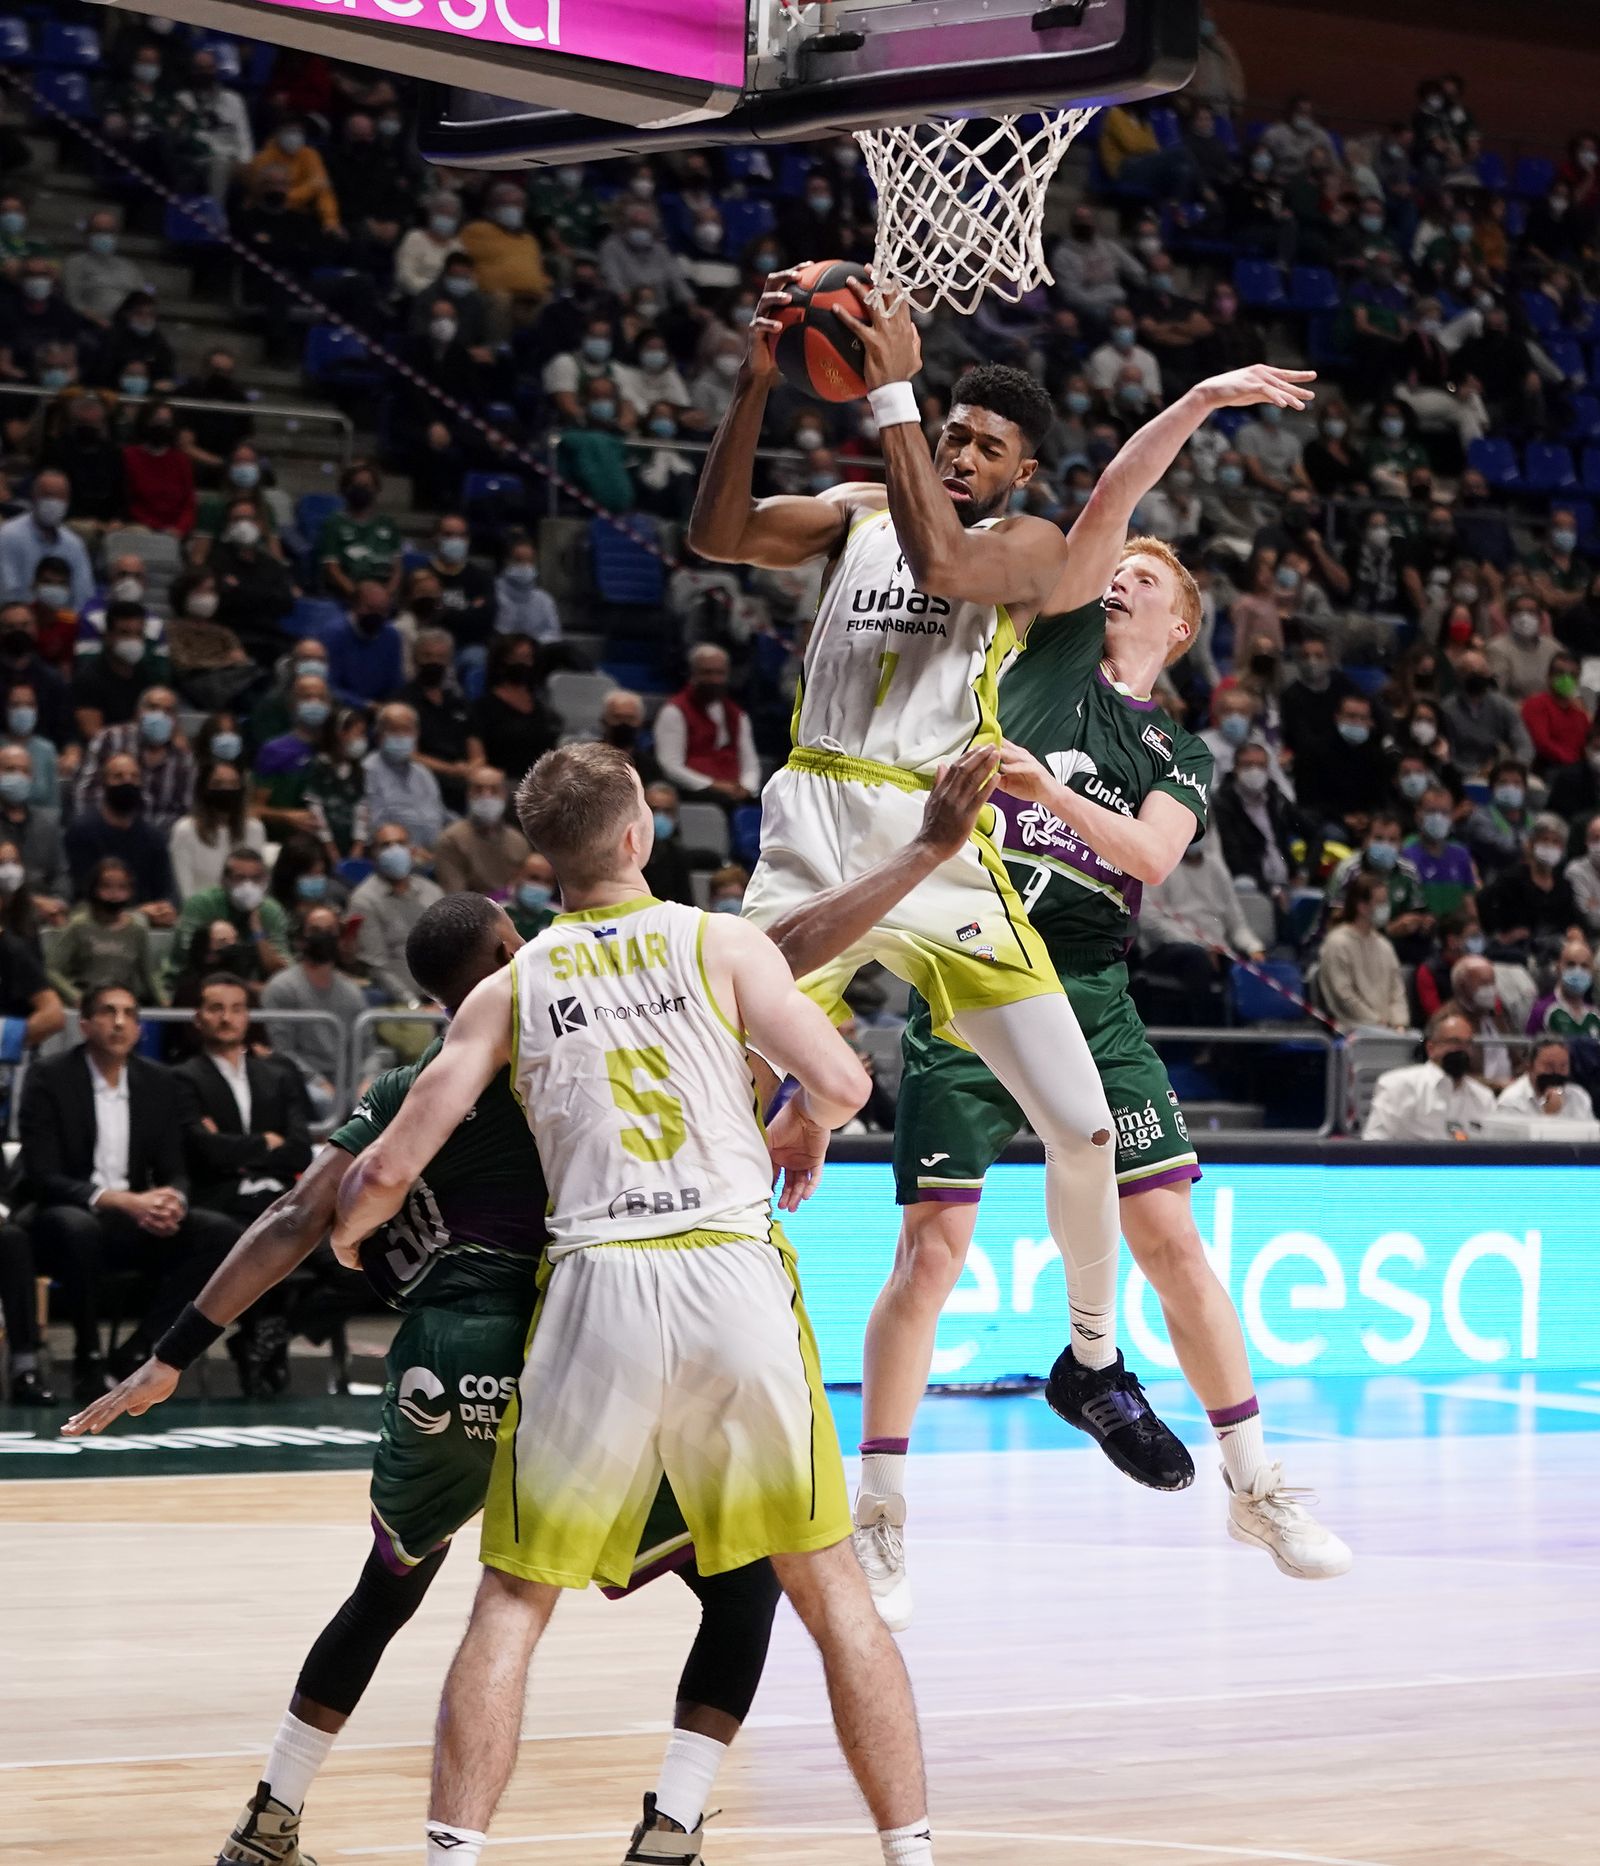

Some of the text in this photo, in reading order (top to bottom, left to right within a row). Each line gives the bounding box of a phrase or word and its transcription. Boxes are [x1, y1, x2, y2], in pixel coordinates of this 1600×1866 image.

[549, 932, 668, 980] SAMAR
[605, 1045, 687, 1162] 5
[459, 1374, 518, 1400] COS
[459, 1403, 502, 1424] DEL
